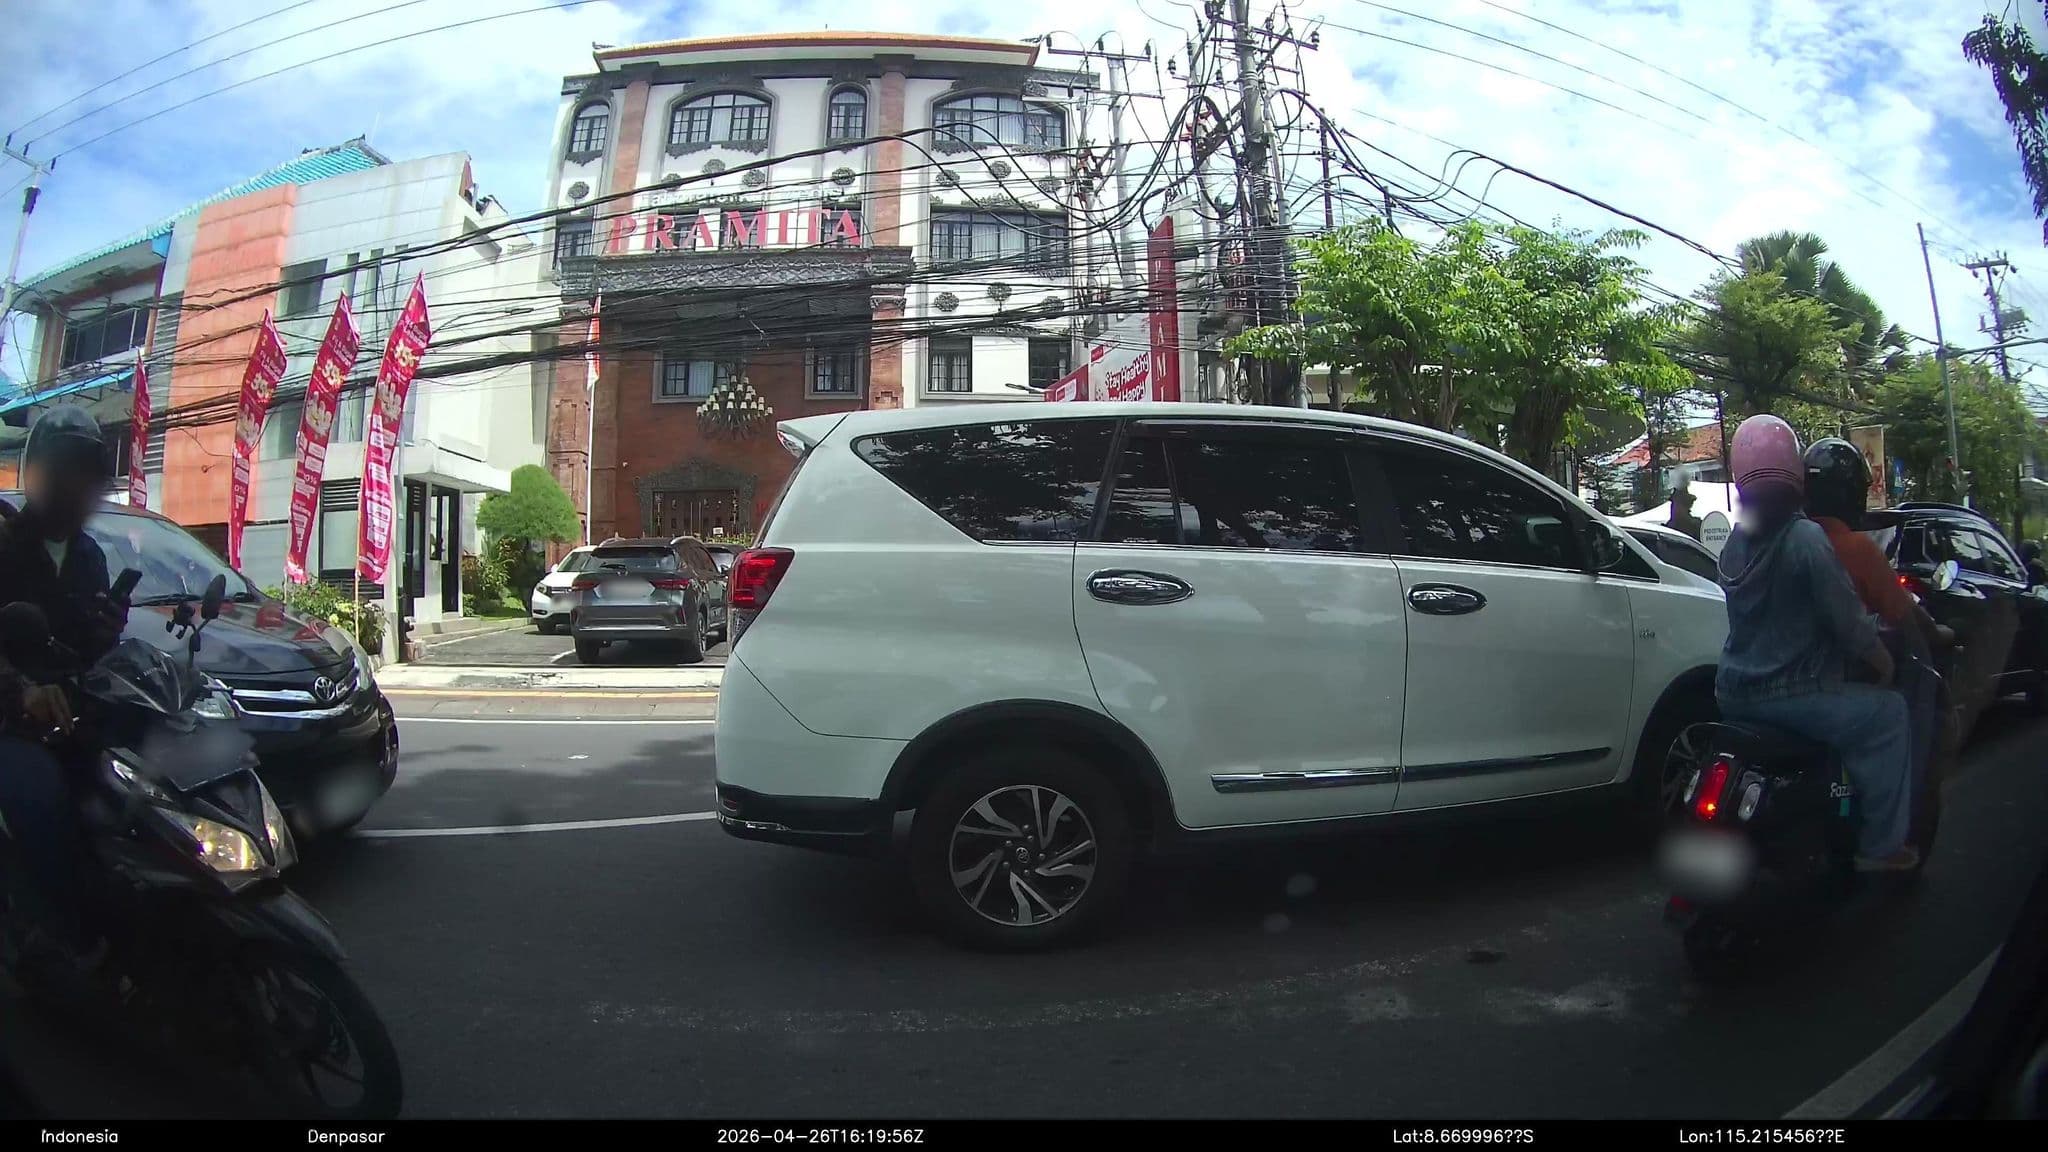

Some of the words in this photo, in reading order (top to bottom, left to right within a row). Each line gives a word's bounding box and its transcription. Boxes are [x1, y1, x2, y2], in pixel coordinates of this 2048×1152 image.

[607, 208, 862, 252] PRAMITA
[1105, 371, 1120, 391] Stay
[1121, 352, 1148, 385] Healthy
